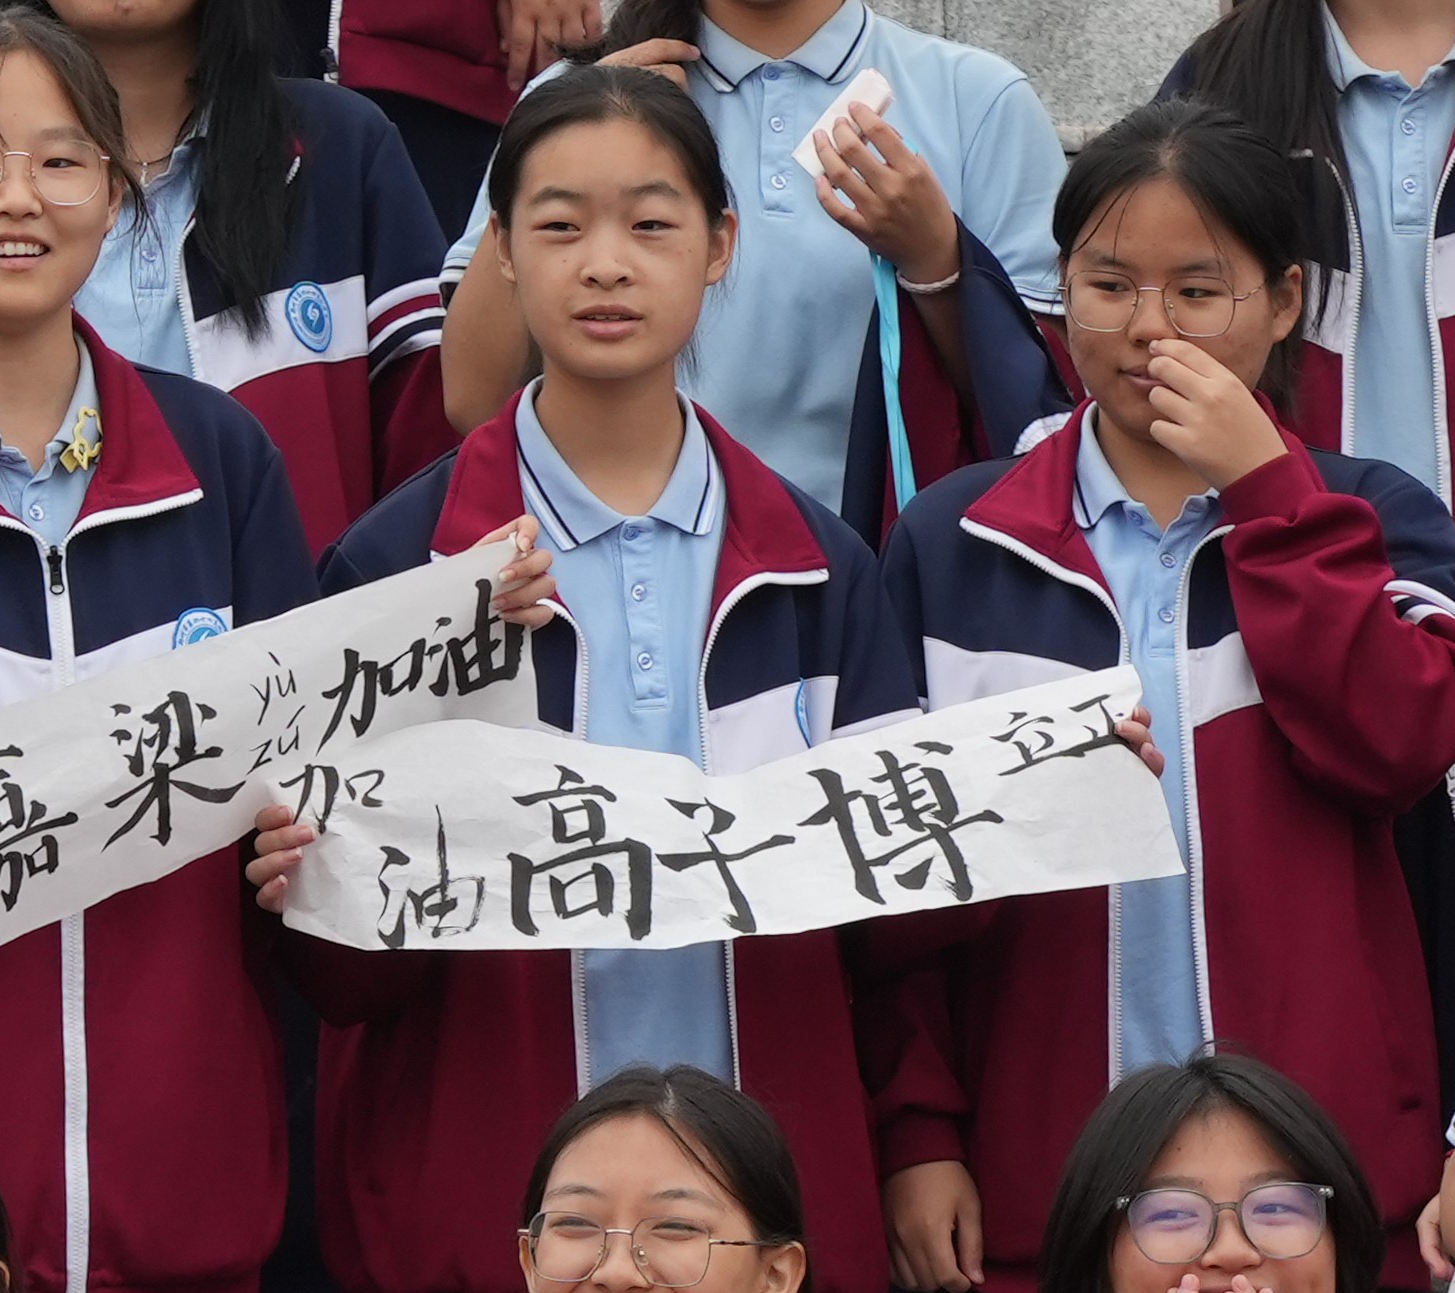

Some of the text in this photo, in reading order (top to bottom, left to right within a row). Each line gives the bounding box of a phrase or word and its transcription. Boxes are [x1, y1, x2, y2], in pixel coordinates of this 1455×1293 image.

[318, 577, 527, 757] 加油
[276, 760, 488, 949] 加油
[506, 739, 1006, 943] 高子博
